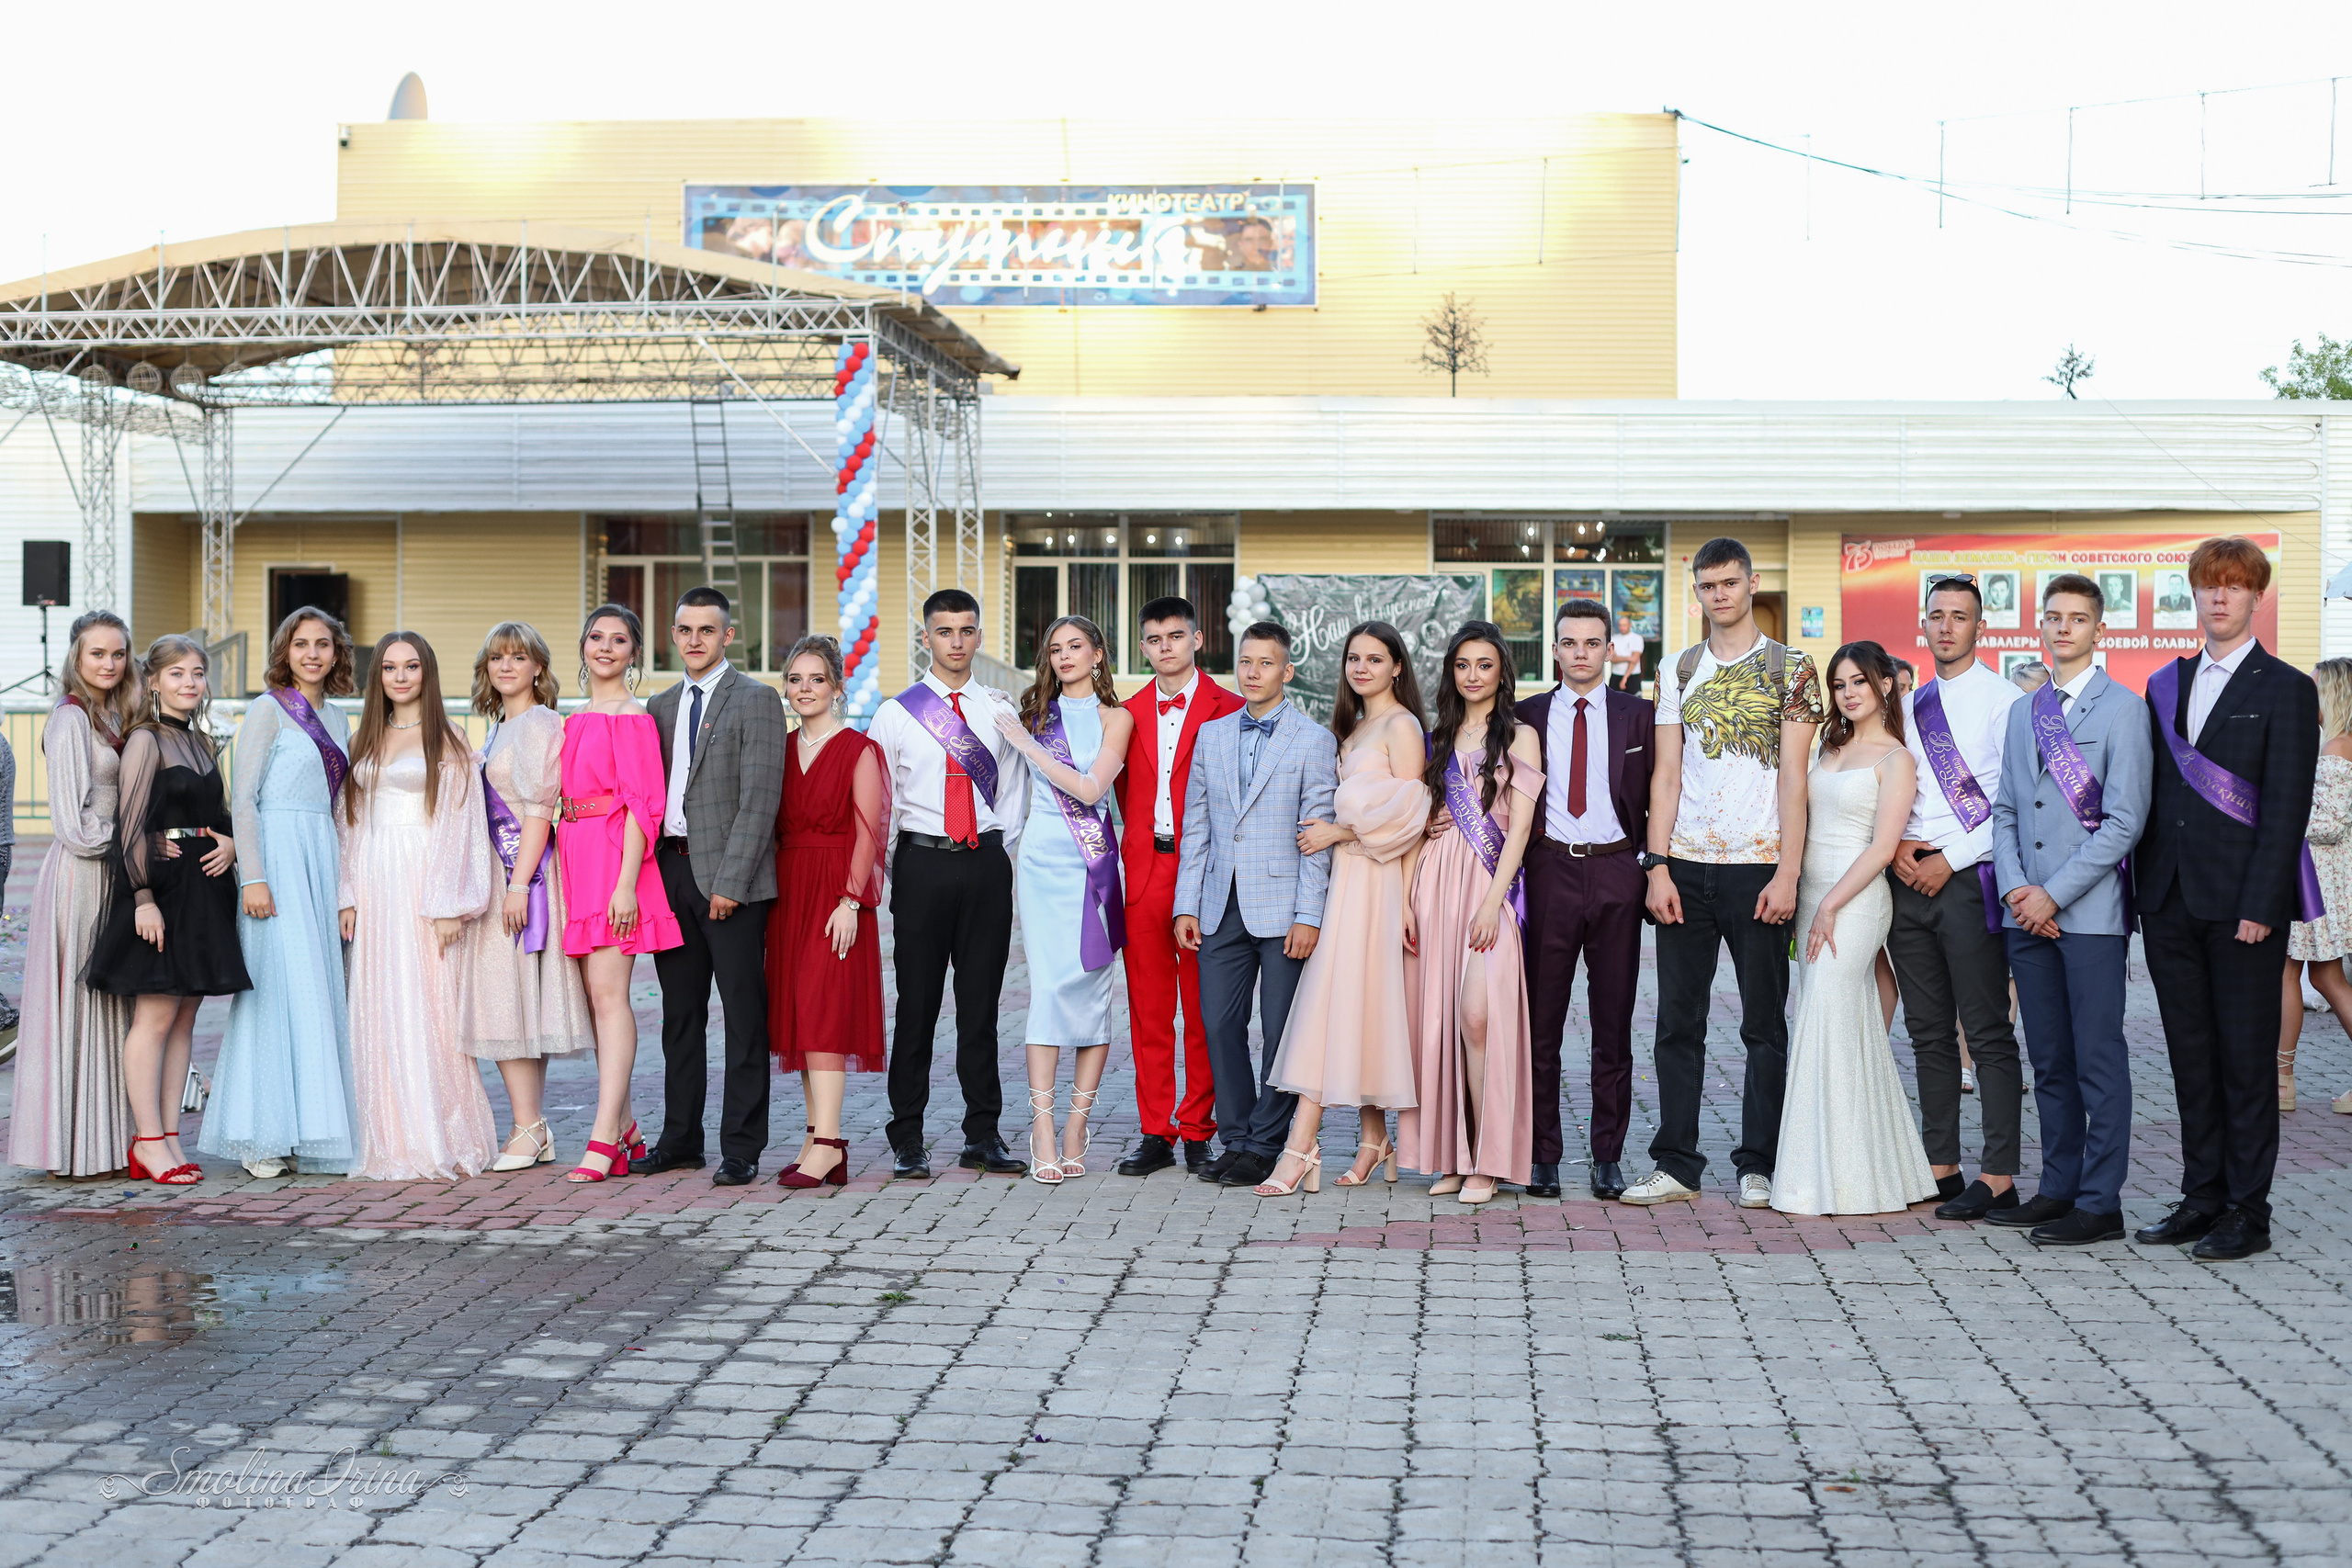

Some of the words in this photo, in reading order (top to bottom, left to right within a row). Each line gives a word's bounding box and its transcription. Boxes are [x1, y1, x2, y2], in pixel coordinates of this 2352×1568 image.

[1107, 193, 1246, 213] КИНОТЕАТР
[1845, 539, 1873, 573] 75
[1912, 552, 1951, 563] НАШИ
[1954, 552, 2015, 563] ЗЕМЛЯКИ
[2027, 552, 2066, 563] ГЕРОИ
[2072, 553, 2153, 563] СОВЕТСКОГО
[1287, 604, 1351, 667] Наш
[2153, 637, 2198, 649] СЛАВЫ
[1928, 731, 1980, 824] Выпускник
[2040, 714, 2089, 808] Выпускник
[2175, 744, 2255, 818] Выпускник
[1444, 772, 1499, 860] Выпускница
[1079, 823, 1109, 860] 2022
